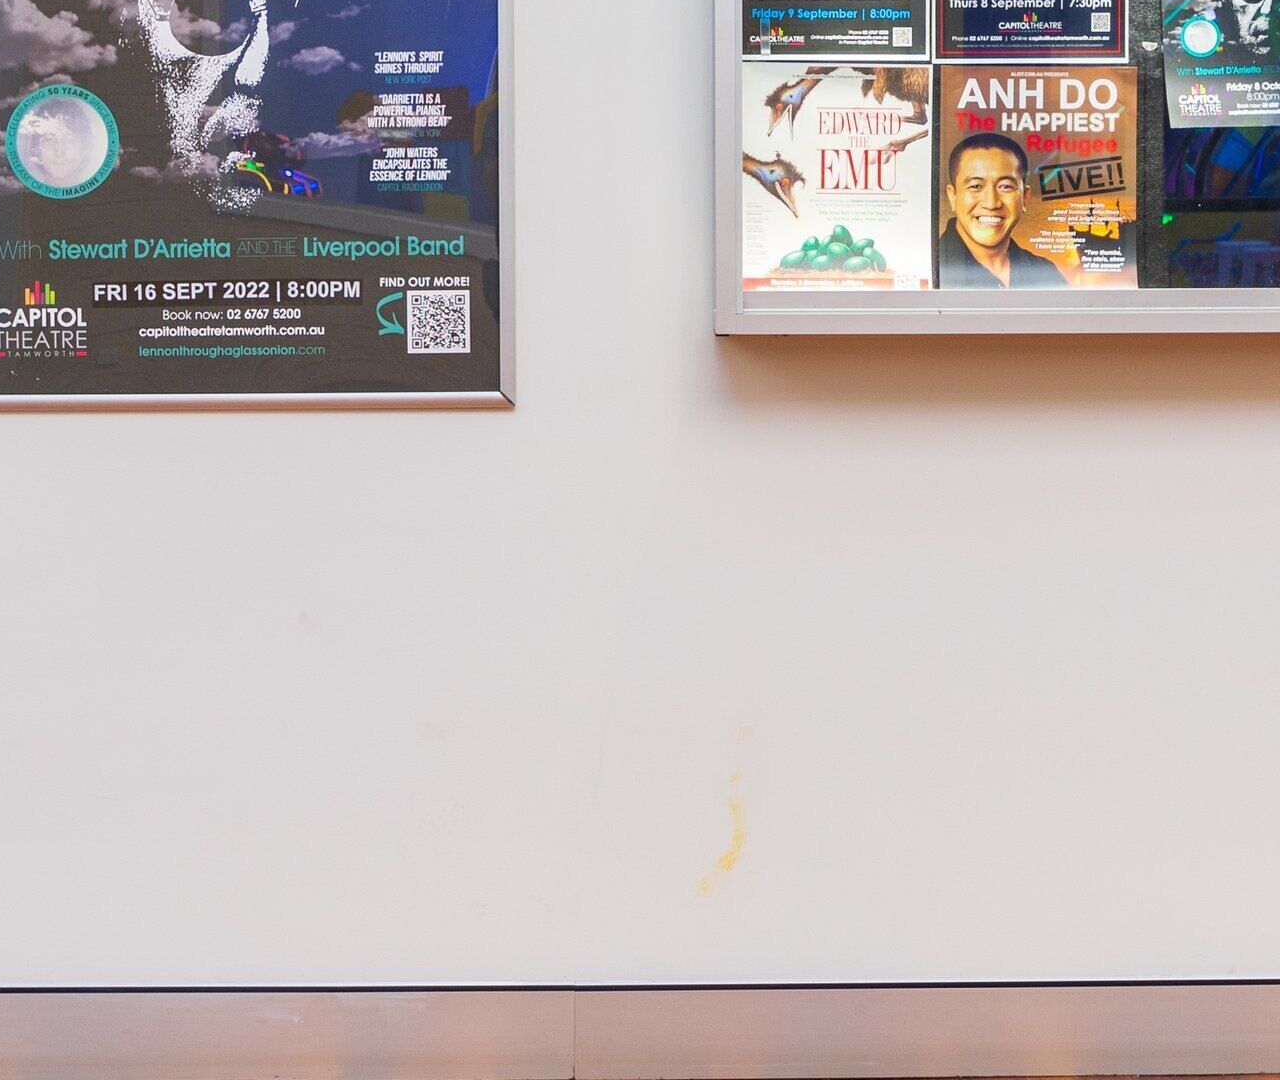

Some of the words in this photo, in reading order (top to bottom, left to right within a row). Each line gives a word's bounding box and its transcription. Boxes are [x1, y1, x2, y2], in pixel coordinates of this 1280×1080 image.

[751, 8, 785, 20] Friday
[788, 8, 794, 19] 9
[797, 8, 857, 20] September
[870, 8, 911, 20] 8:00pm
[957, 78, 1044, 109] ANH
[1059, 78, 1118, 110] DO
[817, 111, 901, 135] EDWARD
[955, 112, 996, 131] The
[1002, 112, 1120, 132] HAPPIEST
[848, 136, 870, 148] THE
[1026, 134, 1118, 157] Refugee
[816, 149, 898, 191] EMU
[1039, 162, 1125, 196] LIVE!!
[48, 238, 127, 259] Stewart
[237, 240, 269, 255] AND
[272, 239, 296, 254] THE
[303, 236, 401, 261] Liverpool
[407, 235, 464, 257] Band
[94, 284, 127, 302] FRI
[134, 284, 157, 301] 16
[162, 282, 217, 301] SEPT
[223, 281, 270, 299] 2022
[287, 280, 361, 299] 8:00PM
[139, 324, 325, 339] capitoltheatretamworth.com.au
[139, 344, 326, 360] lennonthroughaglassonion.com
